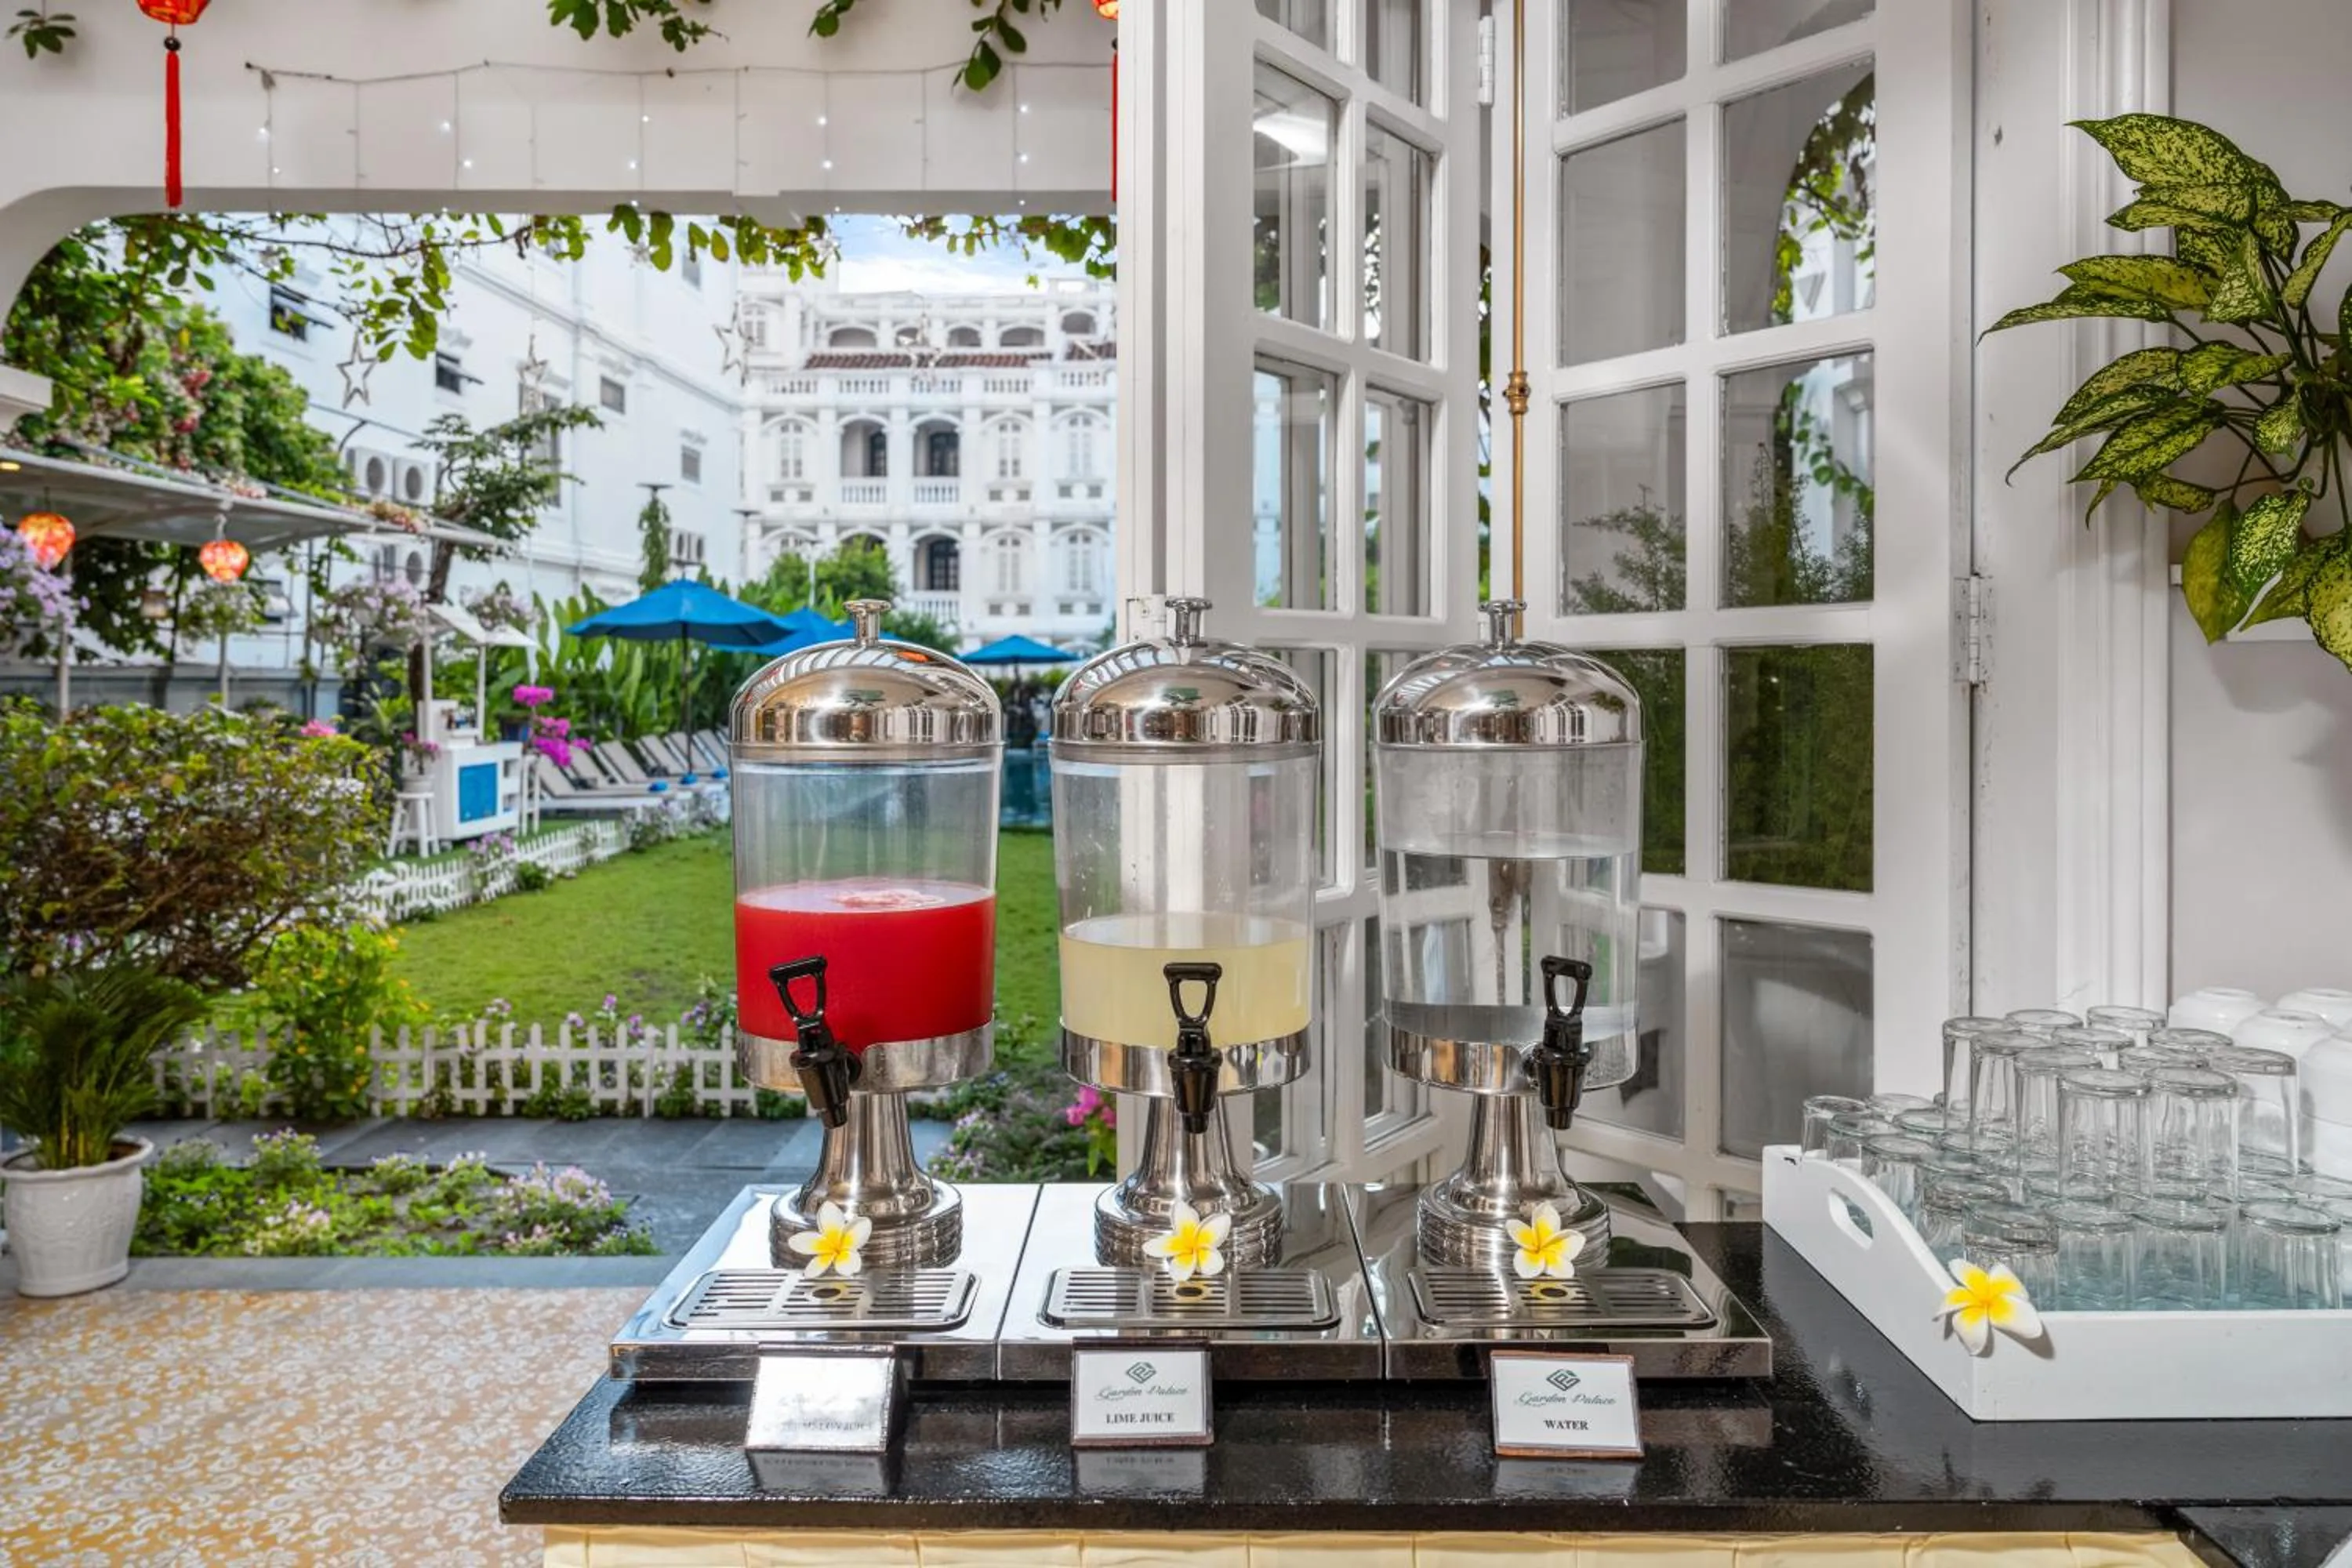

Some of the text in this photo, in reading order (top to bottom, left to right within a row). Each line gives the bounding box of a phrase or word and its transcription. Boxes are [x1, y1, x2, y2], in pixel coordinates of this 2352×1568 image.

[1513, 1392, 1616, 1407] Garden Palace
[1105, 1413, 1175, 1424] LIME JUICE
[1543, 1420, 1588, 1431] WATER
